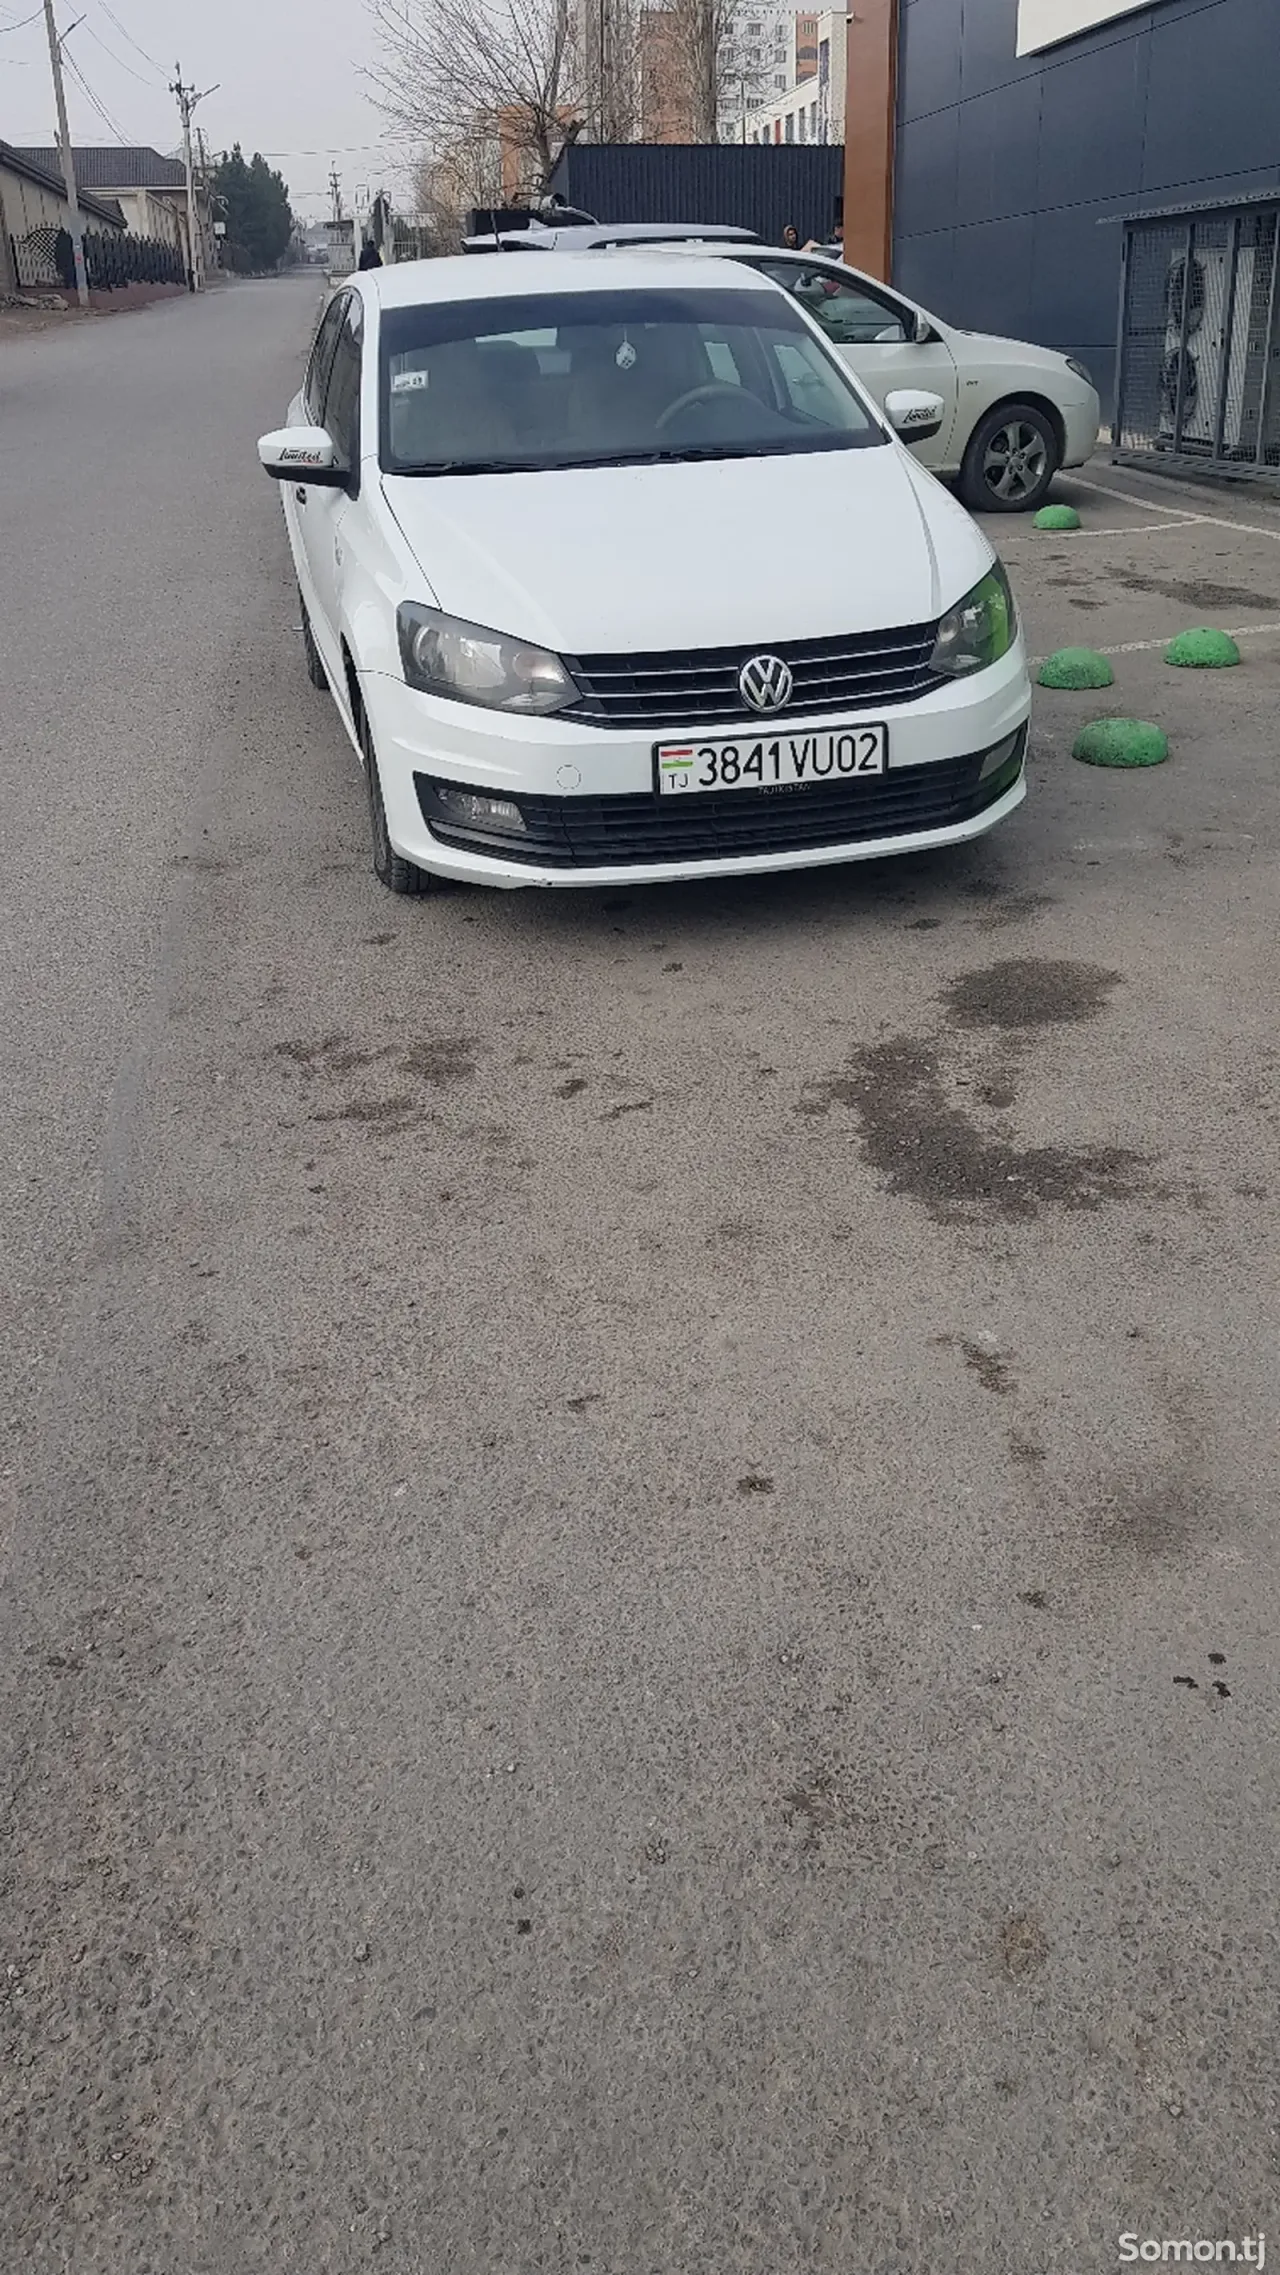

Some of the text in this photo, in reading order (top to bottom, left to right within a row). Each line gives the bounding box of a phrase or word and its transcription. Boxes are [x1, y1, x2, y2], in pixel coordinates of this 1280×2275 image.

[740, 655, 793, 713] VW
[668, 773, 689, 789] TJ
[697, 732, 878, 786] 3841VU02
